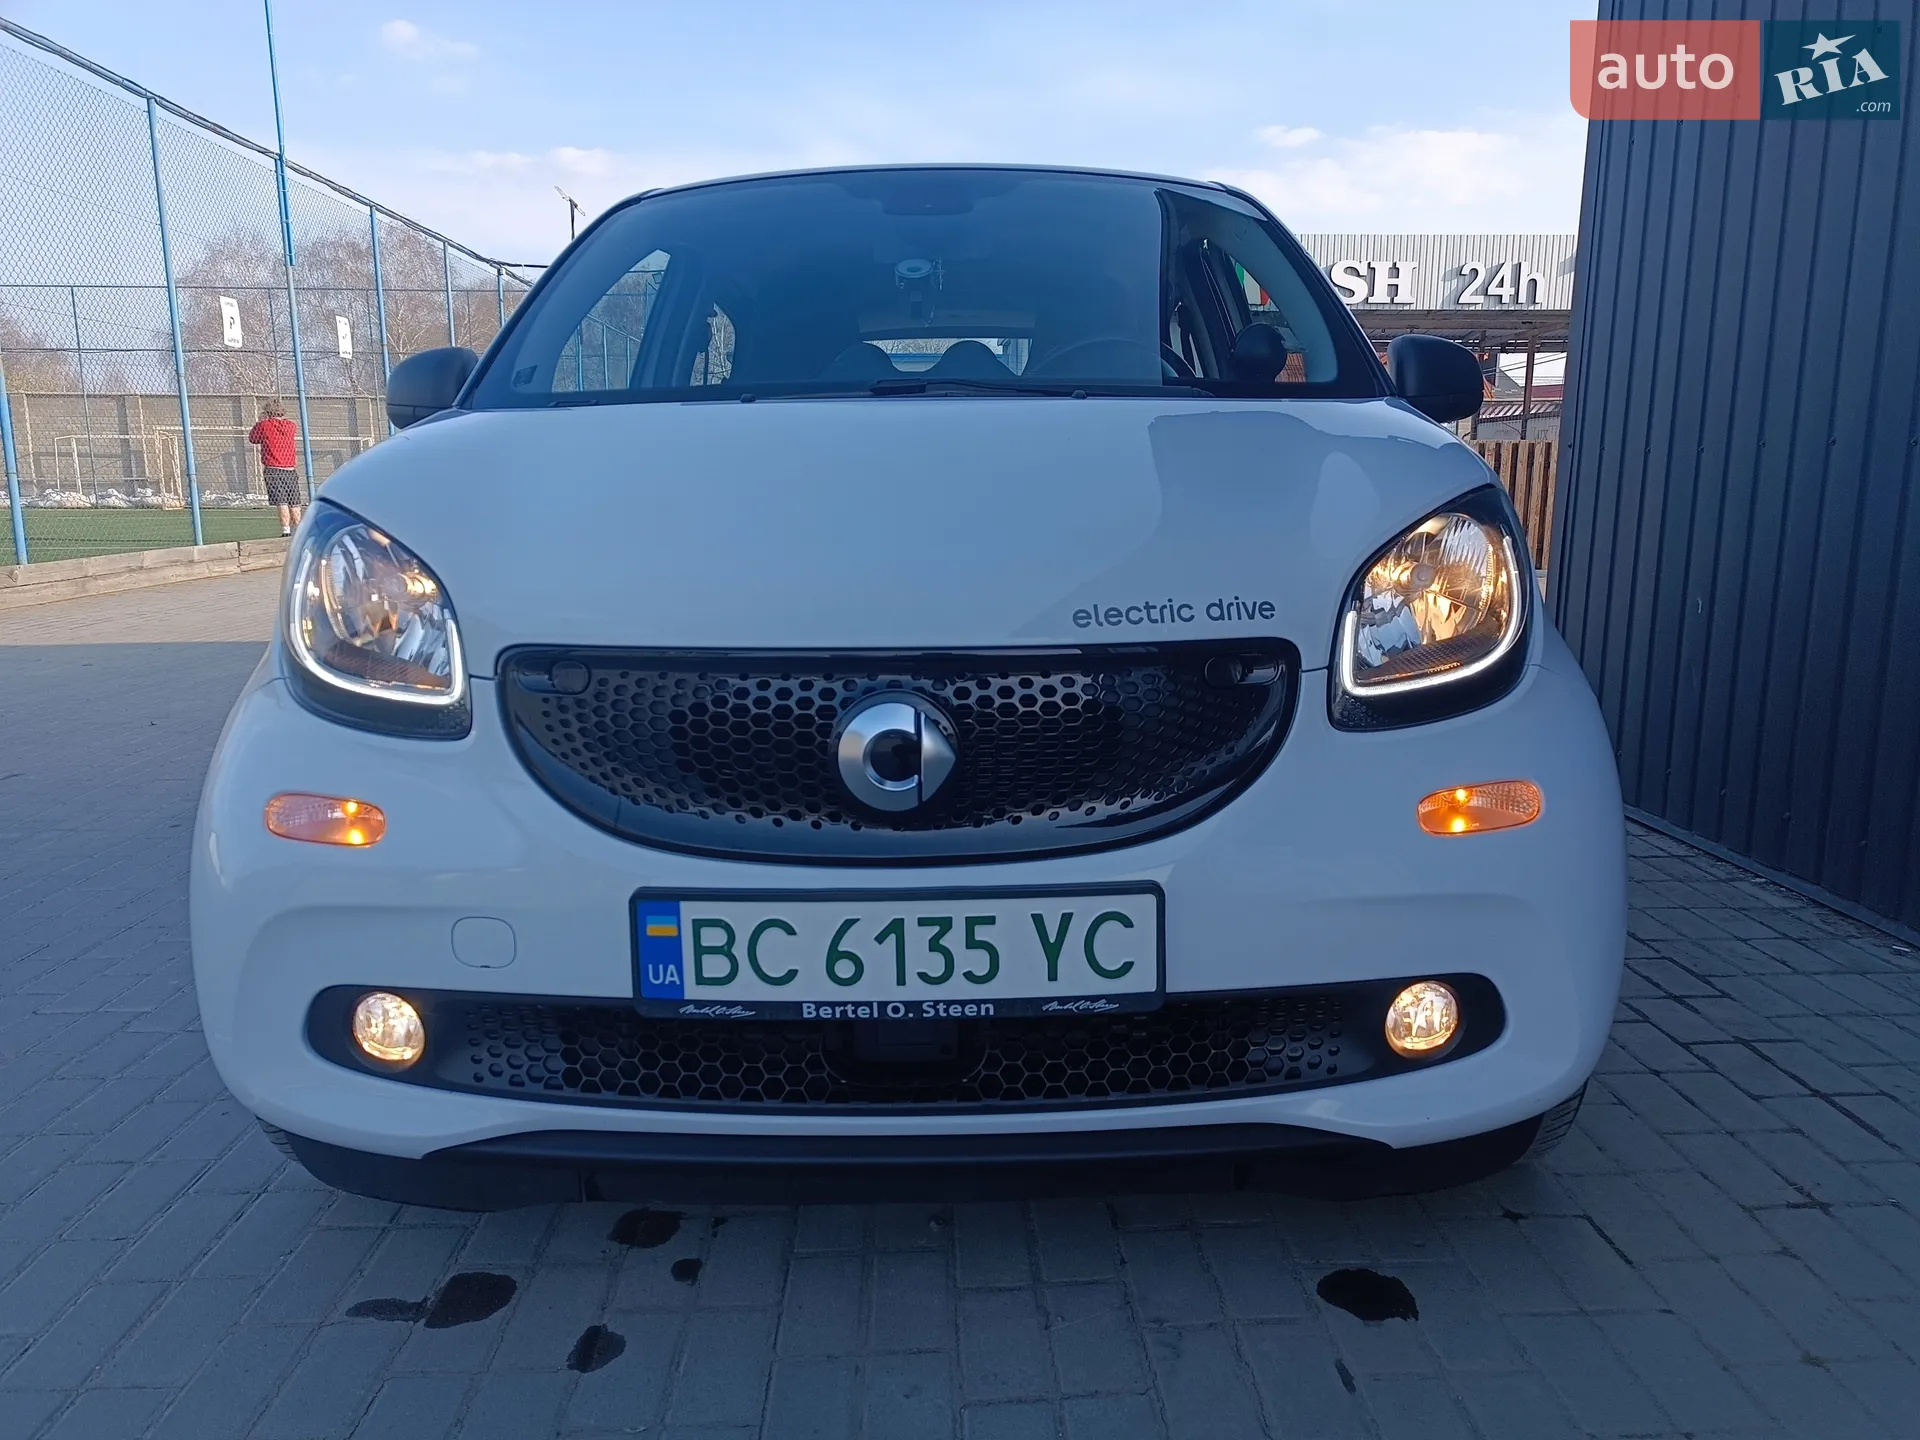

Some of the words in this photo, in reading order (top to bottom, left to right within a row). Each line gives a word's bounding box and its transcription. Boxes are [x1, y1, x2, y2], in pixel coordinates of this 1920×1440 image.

[1459, 260, 1545, 305] 24h
[1072, 598, 1195, 628] electric
[1205, 595, 1275, 621] drive
[691, 918, 799, 987] BC
[825, 915, 1000, 987] 6135
[1031, 911, 1135, 982] YC
[648, 963, 680, 986] UA
[802, 1002, 878, 1019] Bertel
[886, 1001, 917, 1018] O.
[923, 1000, 995, 1017] Steen
